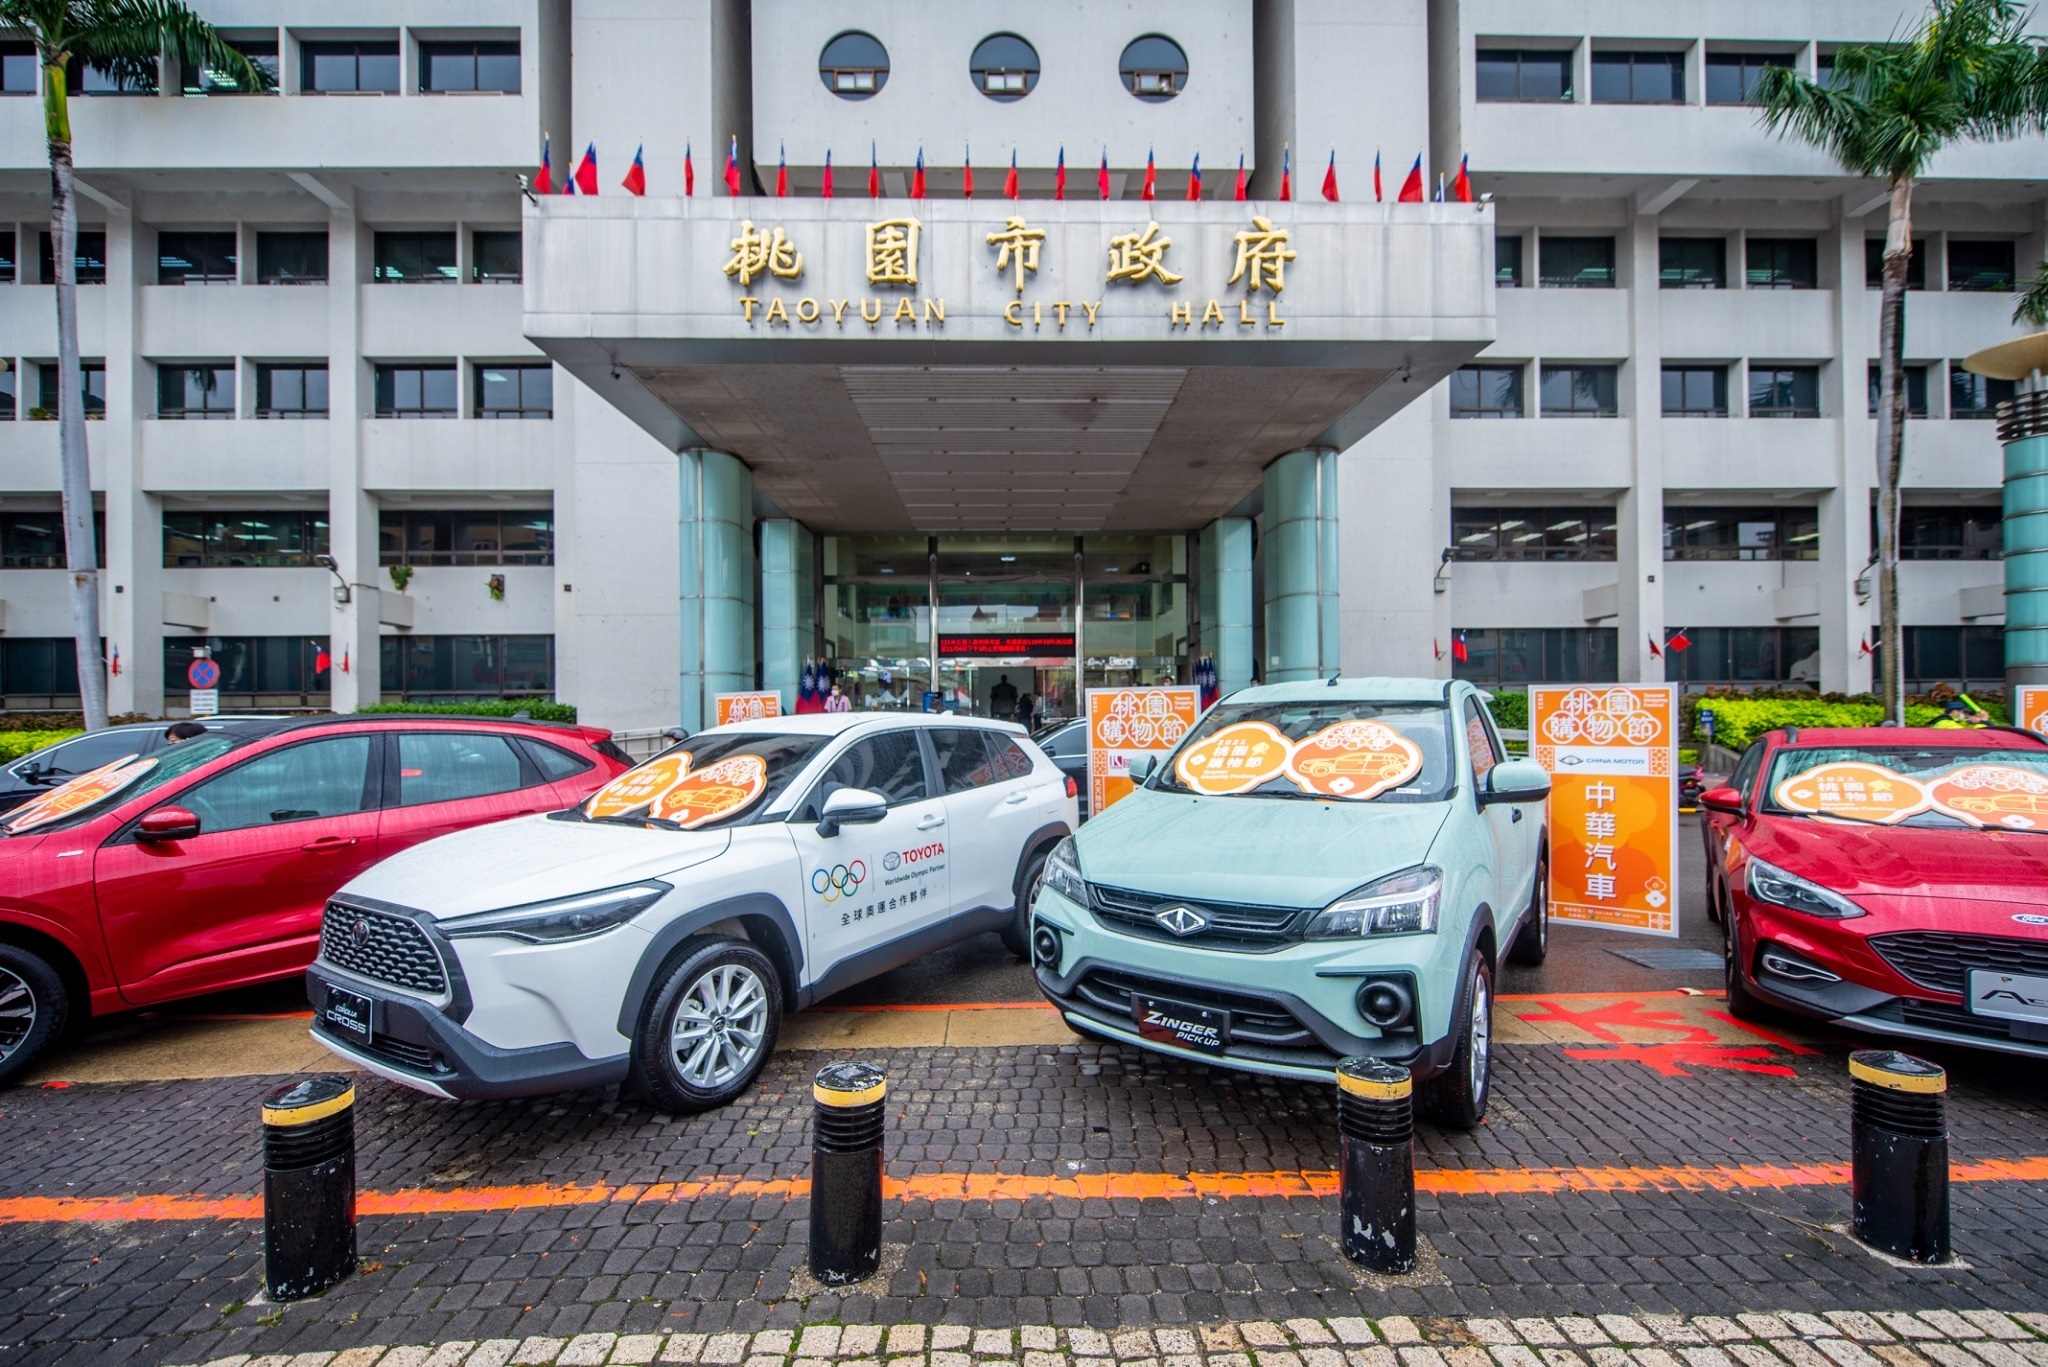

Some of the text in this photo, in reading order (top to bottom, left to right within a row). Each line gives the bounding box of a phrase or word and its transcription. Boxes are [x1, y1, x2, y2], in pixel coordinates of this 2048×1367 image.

[722, 217, 1297, 293] 桃園市政府
[739, 297, 1286, 326] TAOYUAN CITY HALL
[1115, 695, 1167, 718] 桃園
[1564, 691, 1634, 716] 桃園
[1103, 719, 1183, 742] 購物節
[1549, 716, 1653, 740] 購物節
[1213, 745, 1249, 757] 桃園
[1584, 780, 1617, 901] 中華汽車
[902, 842, 945, 864] TOYOTA
[884, 873, 910, 886] Worldwide
[910, 868, 928, 879] Olympic
[841, 888, 927, 926] 全球奧運合作夥伴
[327, 1010, 366, 1034] CROSS
[335, 1005, 357, 1018] COROLLA
